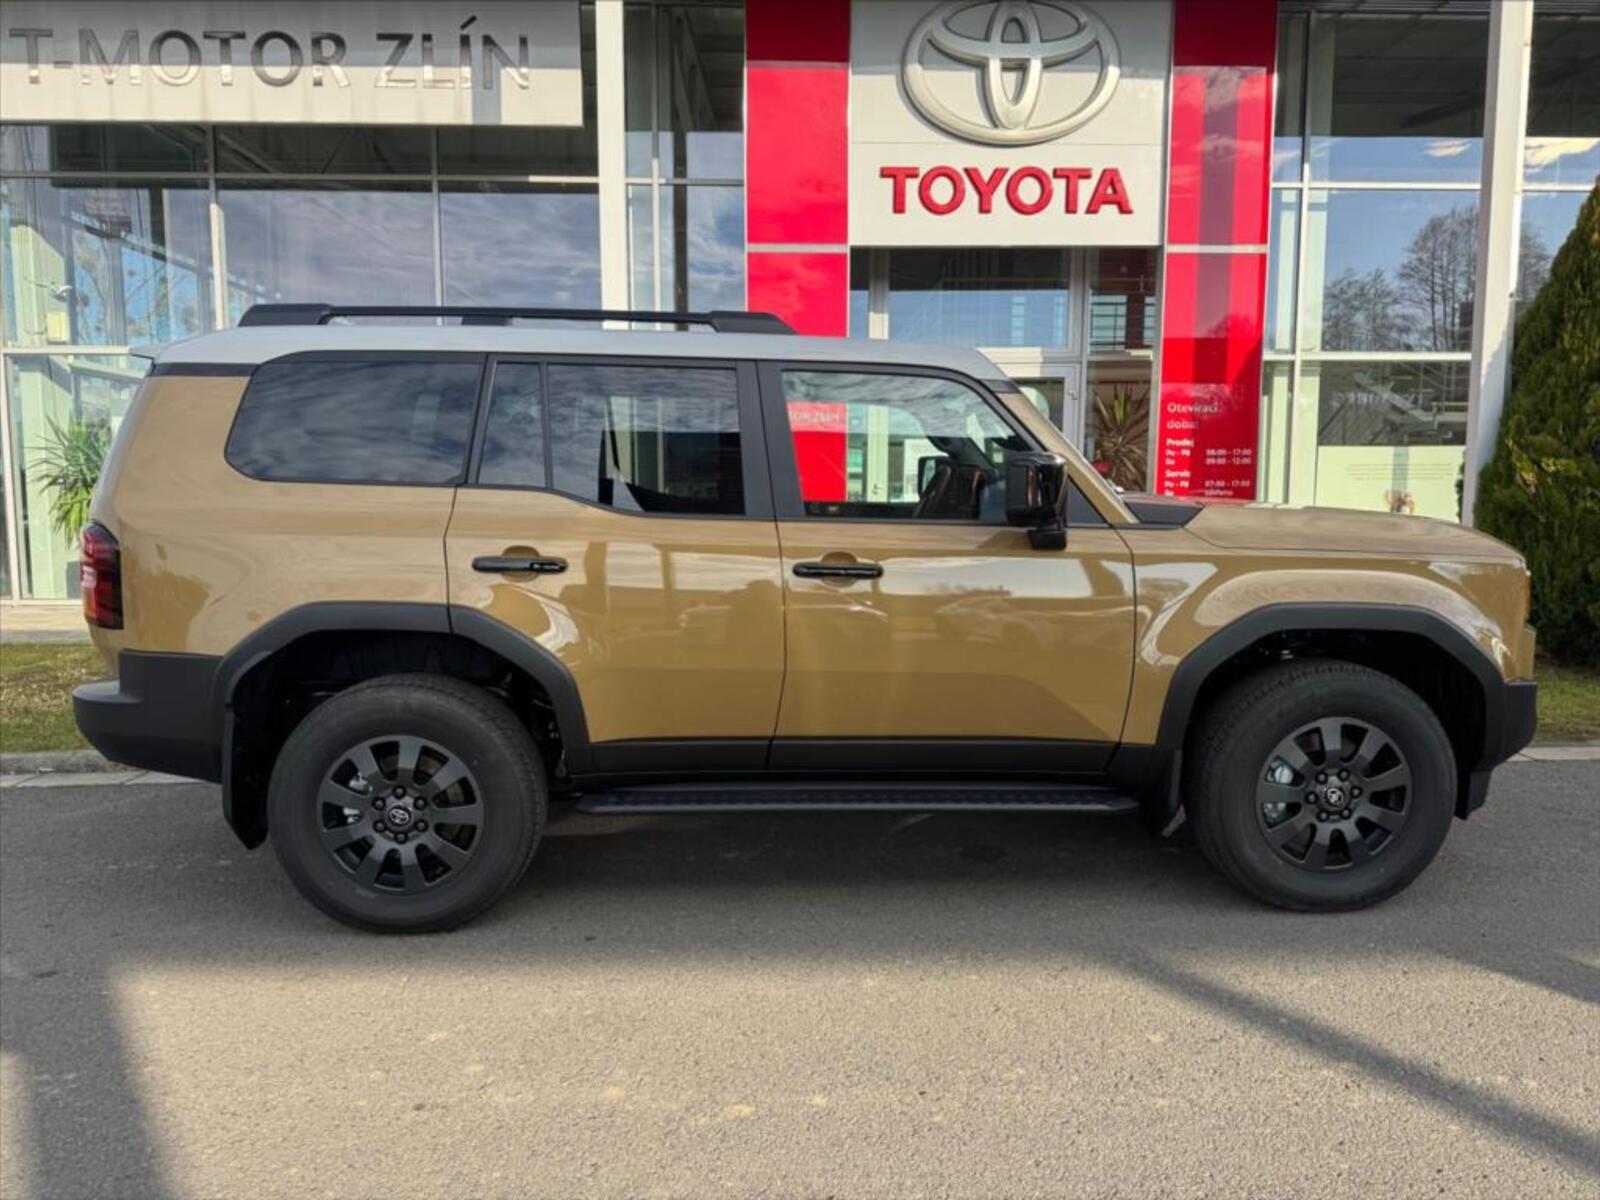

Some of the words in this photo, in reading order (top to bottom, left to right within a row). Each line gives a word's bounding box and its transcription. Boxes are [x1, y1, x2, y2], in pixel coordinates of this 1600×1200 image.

[9, 28, 350, 88] T-MOTOR
[375, 14, 529, 90] ZLÍN
[879, 165, 1134, 216] TOYOTA
